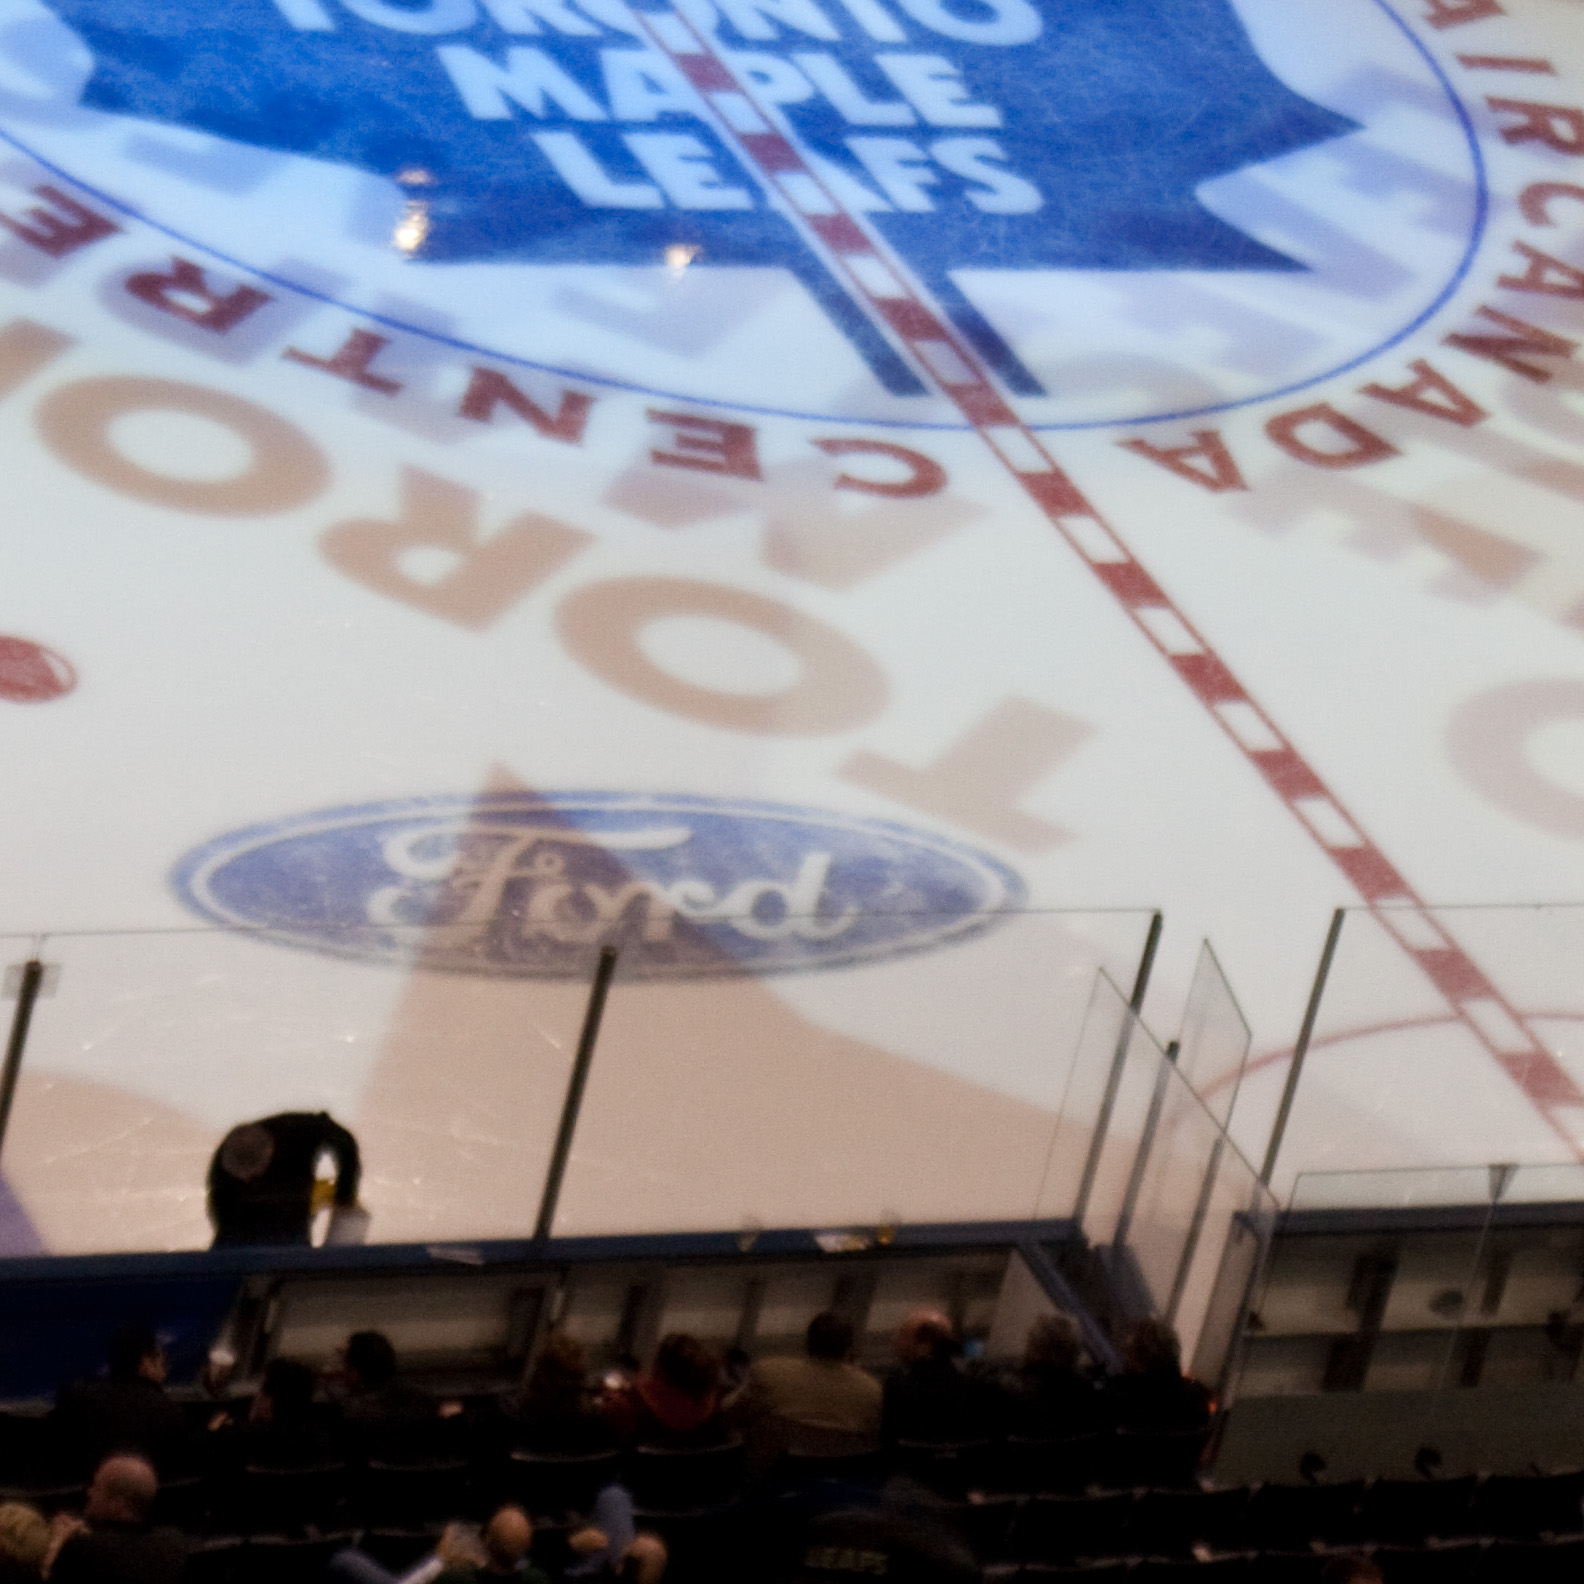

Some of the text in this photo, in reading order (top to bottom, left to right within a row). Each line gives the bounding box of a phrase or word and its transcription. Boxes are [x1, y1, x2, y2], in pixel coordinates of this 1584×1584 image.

[434, 42, 1005, 129] MAPLE
[530, 129, 1047, 216] LEAFS
[364, 818, 861, 946] Ford
